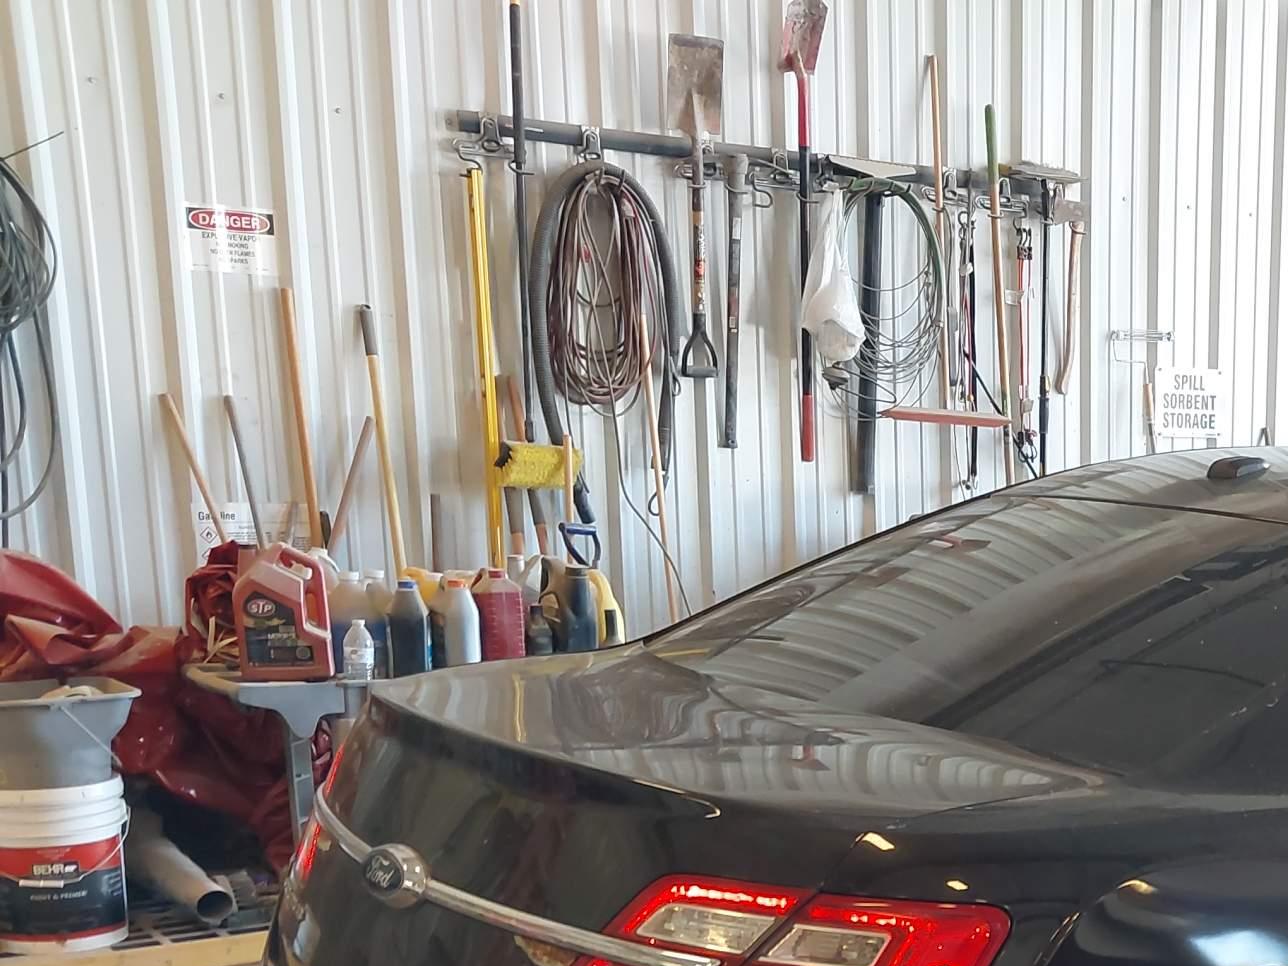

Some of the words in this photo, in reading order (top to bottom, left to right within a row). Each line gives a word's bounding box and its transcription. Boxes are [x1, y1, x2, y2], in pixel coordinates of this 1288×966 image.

[1174, 374, 1205, 391] SPILL
[1163, 393, 1217, 411] SORBENT
[1163, 412, 1216, 430] STORAGE
[250, 600, 273, 614] STP
[32, 863, 65, 876] BEHR
[366, 855, 395, 889] Ford
